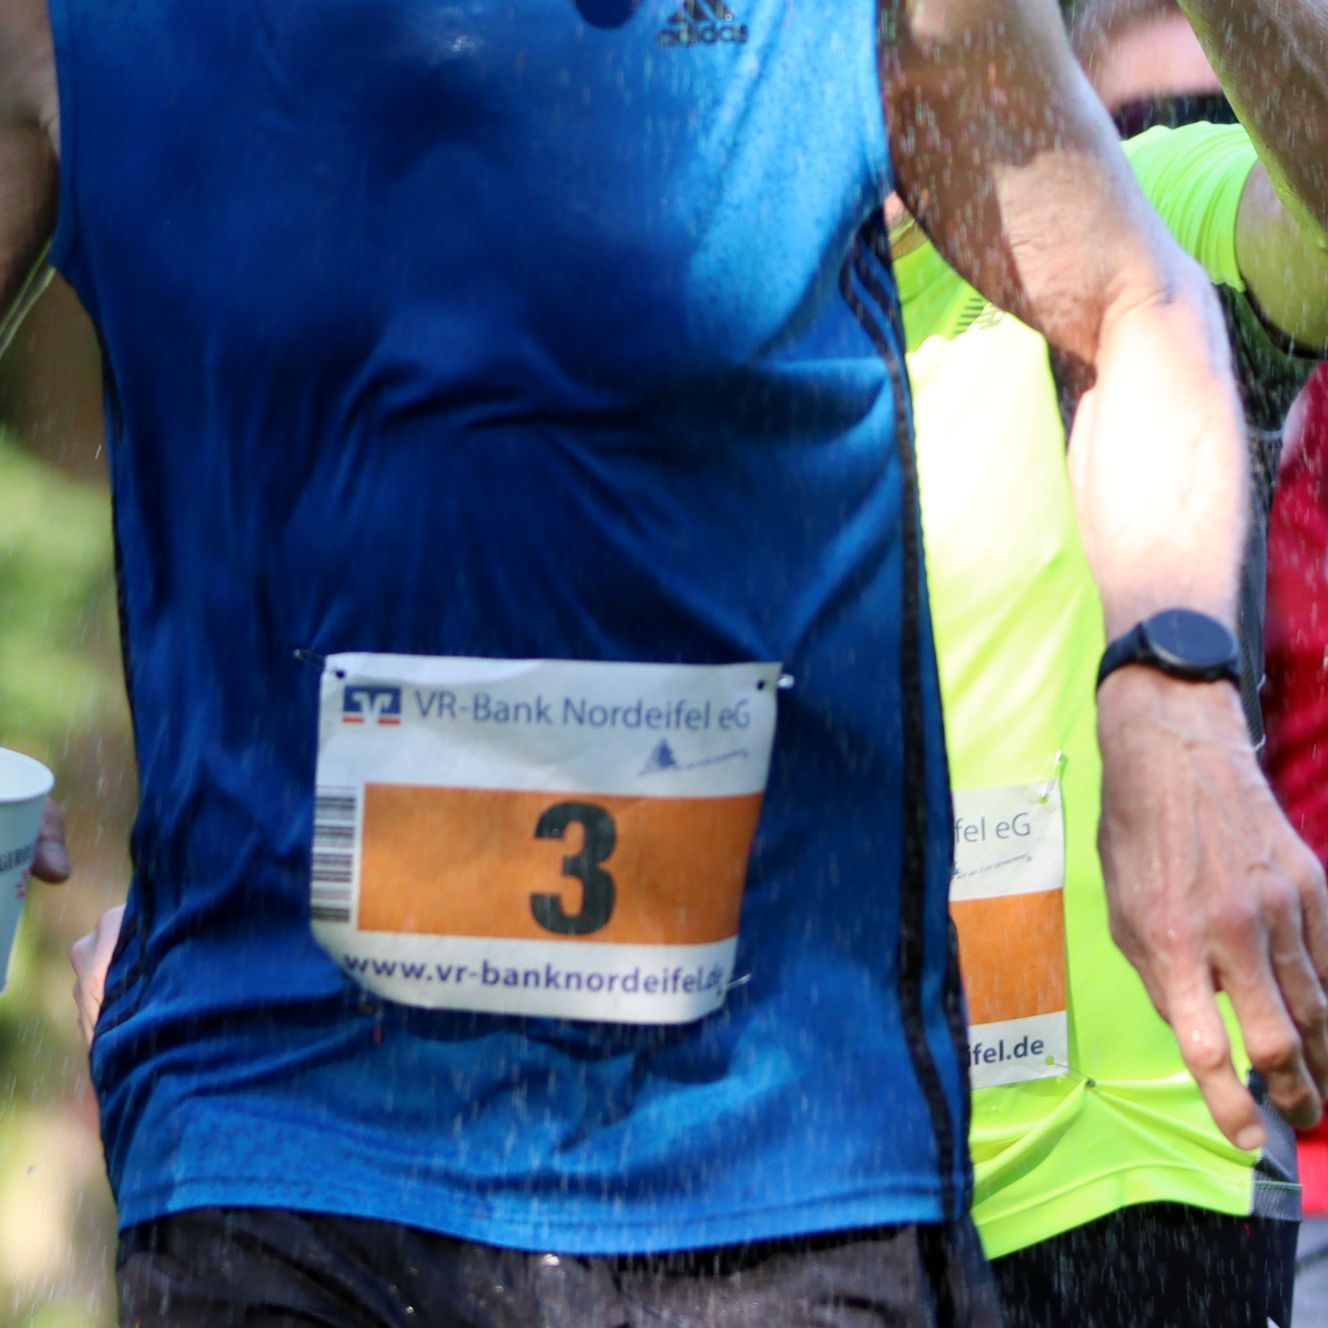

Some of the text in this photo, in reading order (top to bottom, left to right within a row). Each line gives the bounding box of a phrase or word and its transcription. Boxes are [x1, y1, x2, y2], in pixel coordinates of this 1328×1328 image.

[414, 690, 752, 731] VR-Bank Nordeifel eG
[995, 812, 1031, 840] eG
[529, 800, 618, 936] 3
